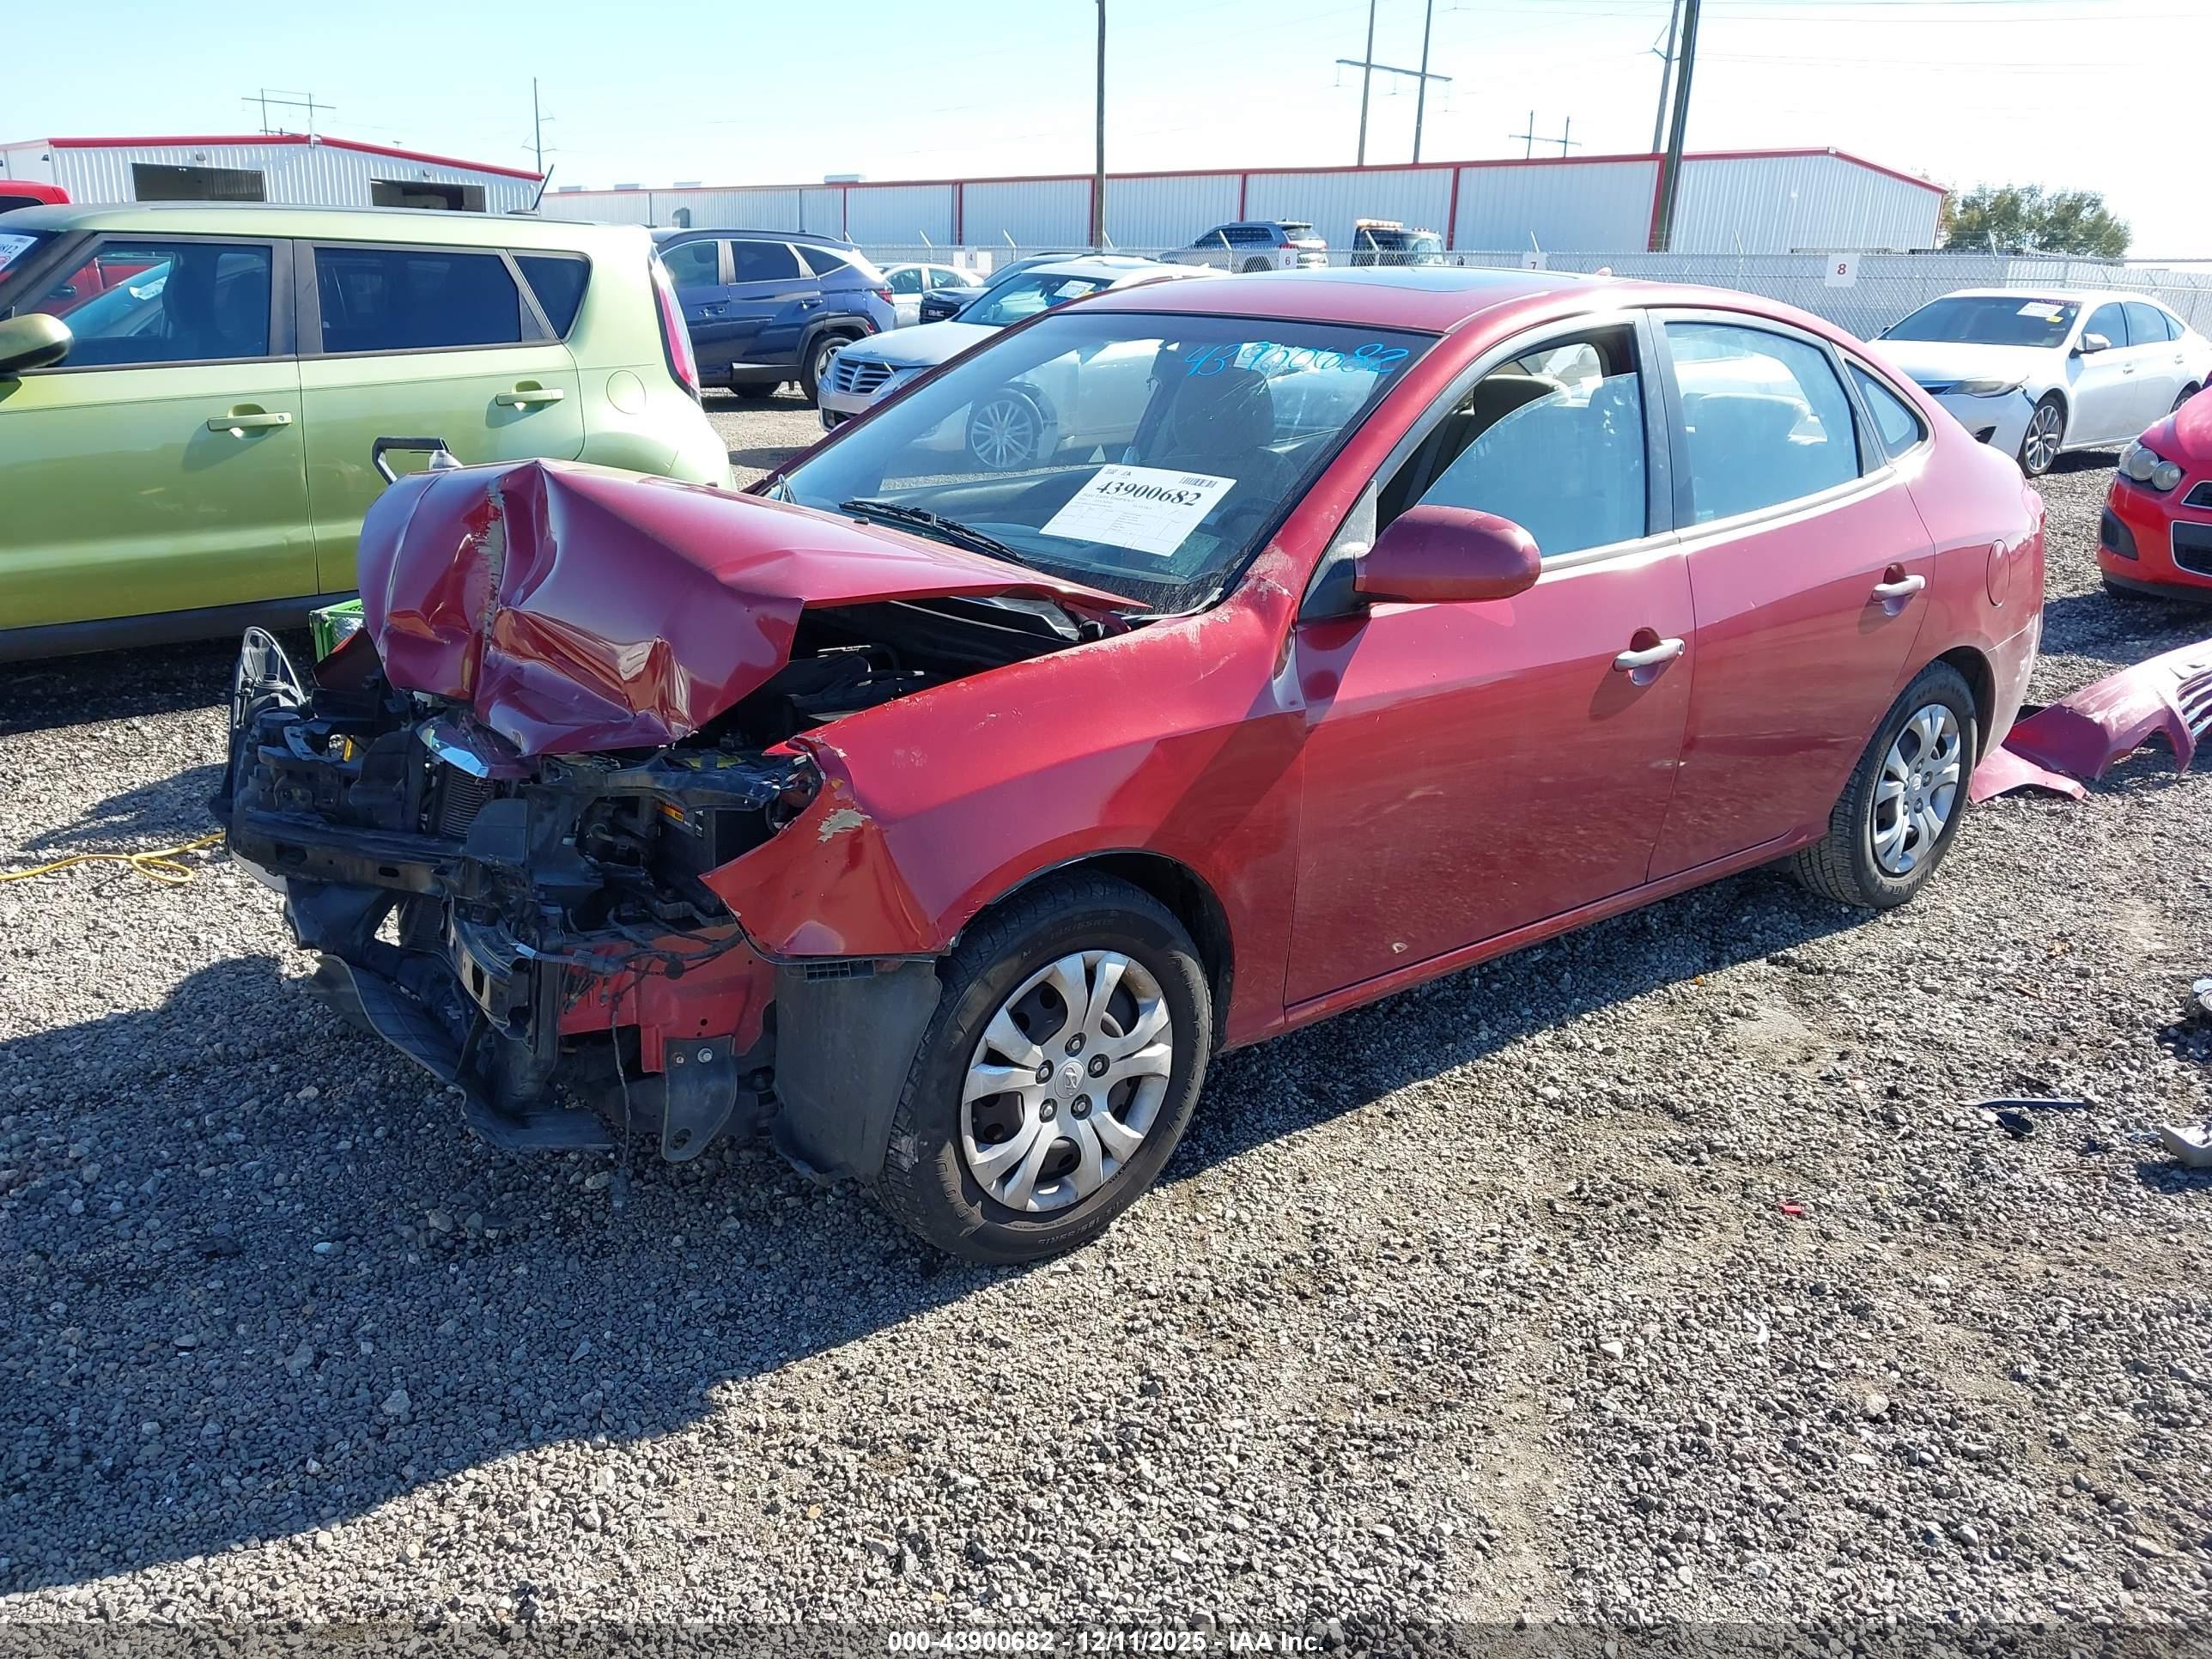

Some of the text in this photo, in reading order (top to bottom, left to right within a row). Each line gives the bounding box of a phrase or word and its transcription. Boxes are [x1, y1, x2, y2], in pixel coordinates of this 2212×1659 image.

[1285, 256, 1291, 265] 6
[1530, 261, 1538, 270] 7
[1837, 263, 1847, 276] 8
[1184, 340, 1410, 376] 43900682
[1096, 480, 1202, 507] 43900682
